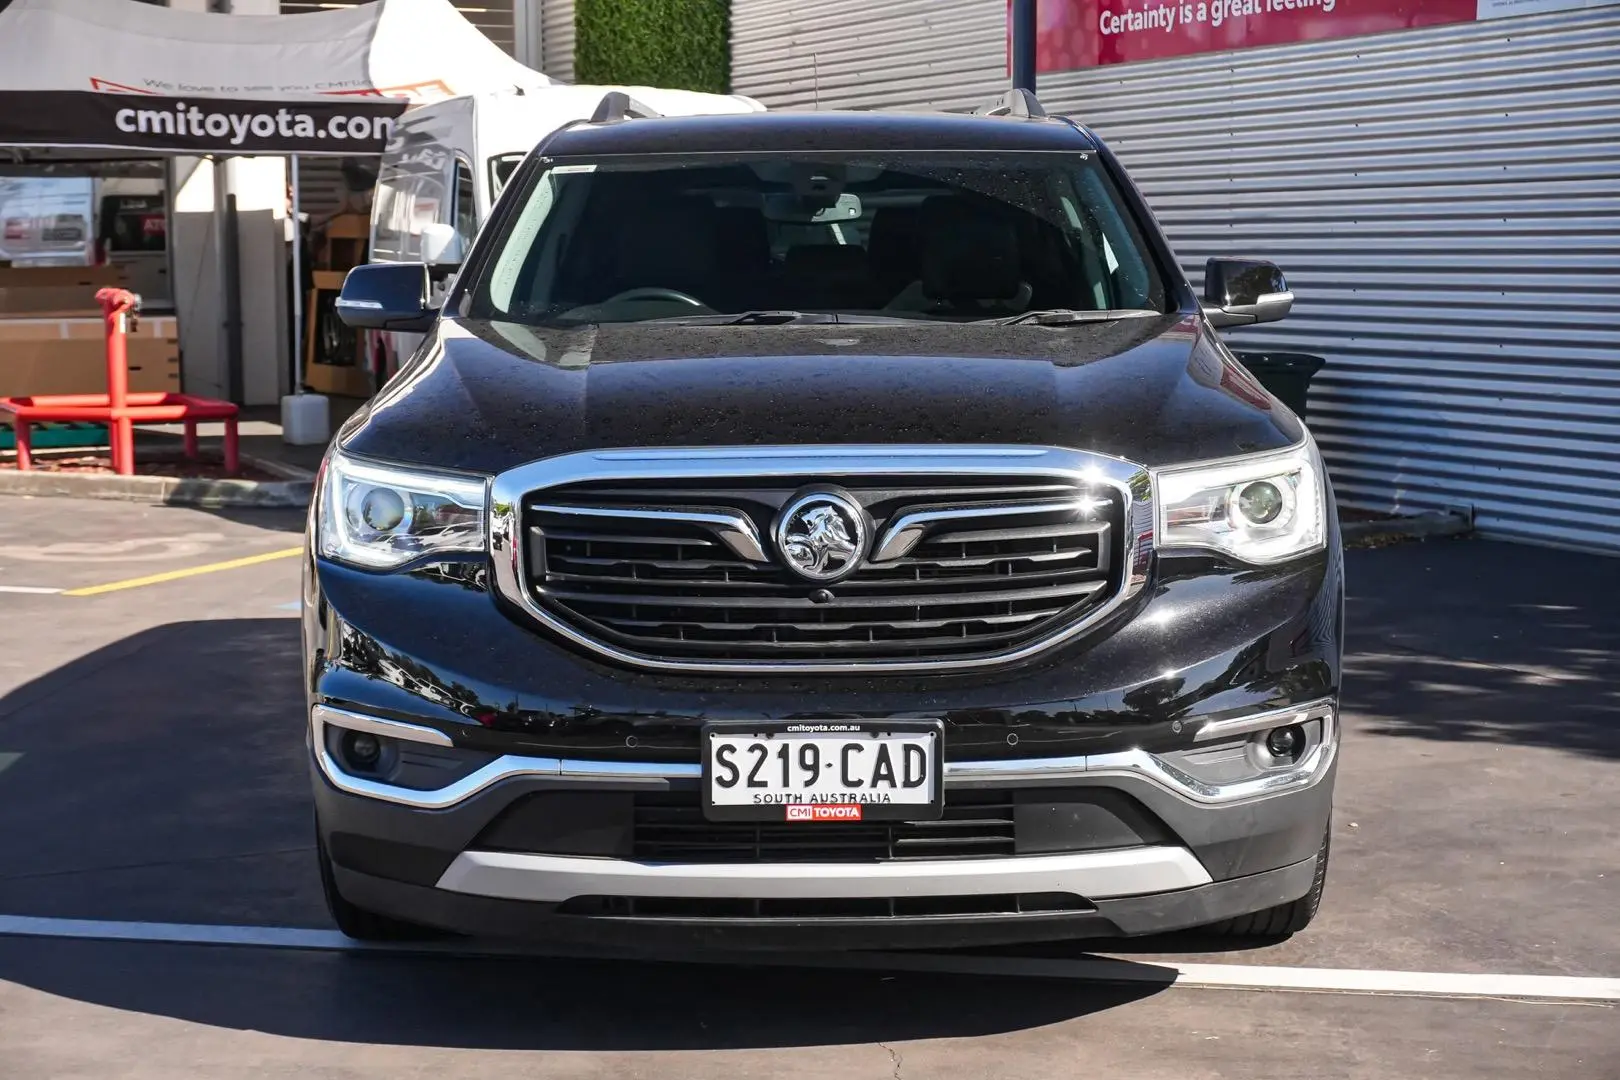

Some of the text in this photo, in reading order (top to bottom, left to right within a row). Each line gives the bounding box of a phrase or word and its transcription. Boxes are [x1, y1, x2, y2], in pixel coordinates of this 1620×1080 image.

[1099, 7, 1176, 35] Certainty
[1179, 2, 1193, 24] is
[1196, 3, 1207, 22] a
[1211, 0, 1261, 27] great
[787, 724, 860, 733] cmitoyota.com.au
[753, 793, 891, 804] SOUTH AUSTRALIA
[789, 807, 860, 817] CMI TOYOTA
